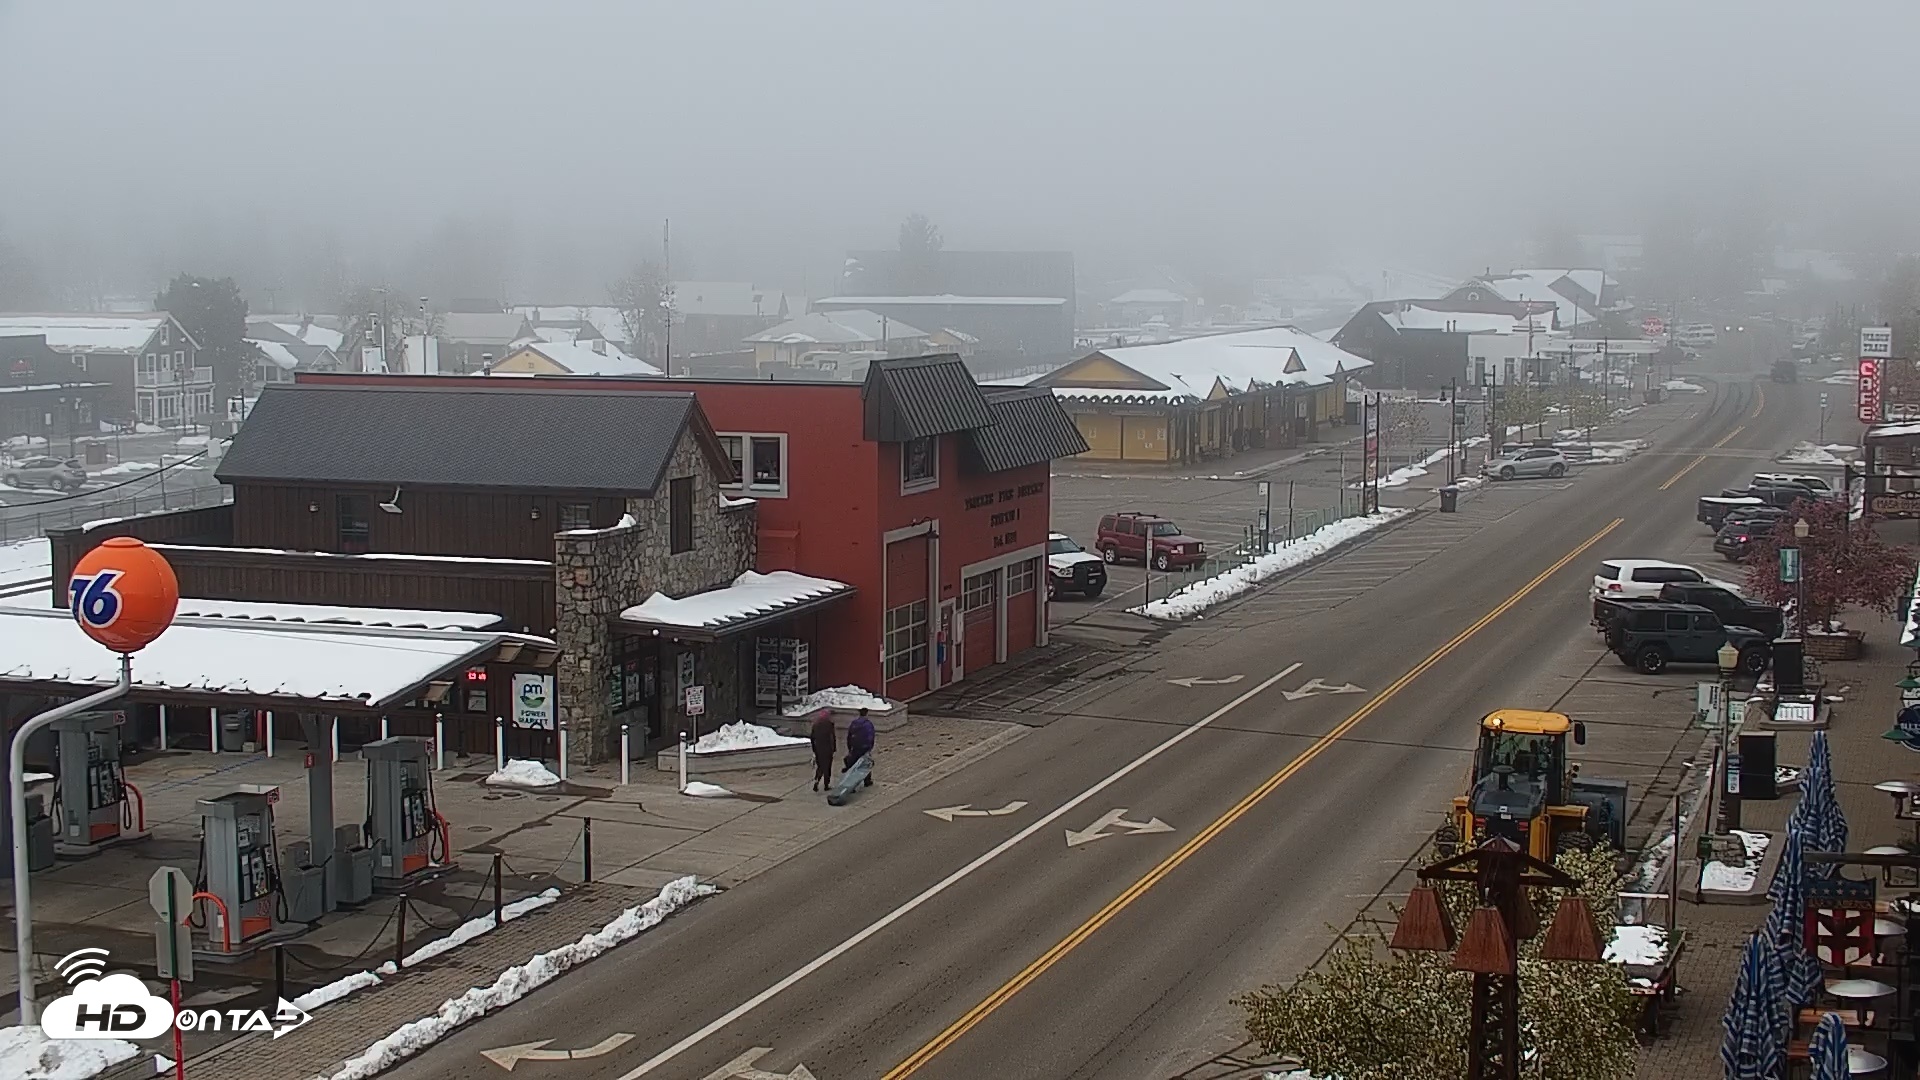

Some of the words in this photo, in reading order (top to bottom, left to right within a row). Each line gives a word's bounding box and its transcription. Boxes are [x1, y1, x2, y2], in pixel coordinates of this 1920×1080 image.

[1859, 361, 1874, 420] CAFE
[68, 568, 126, 628] 76
[520, 709, 547, 718] POWER
